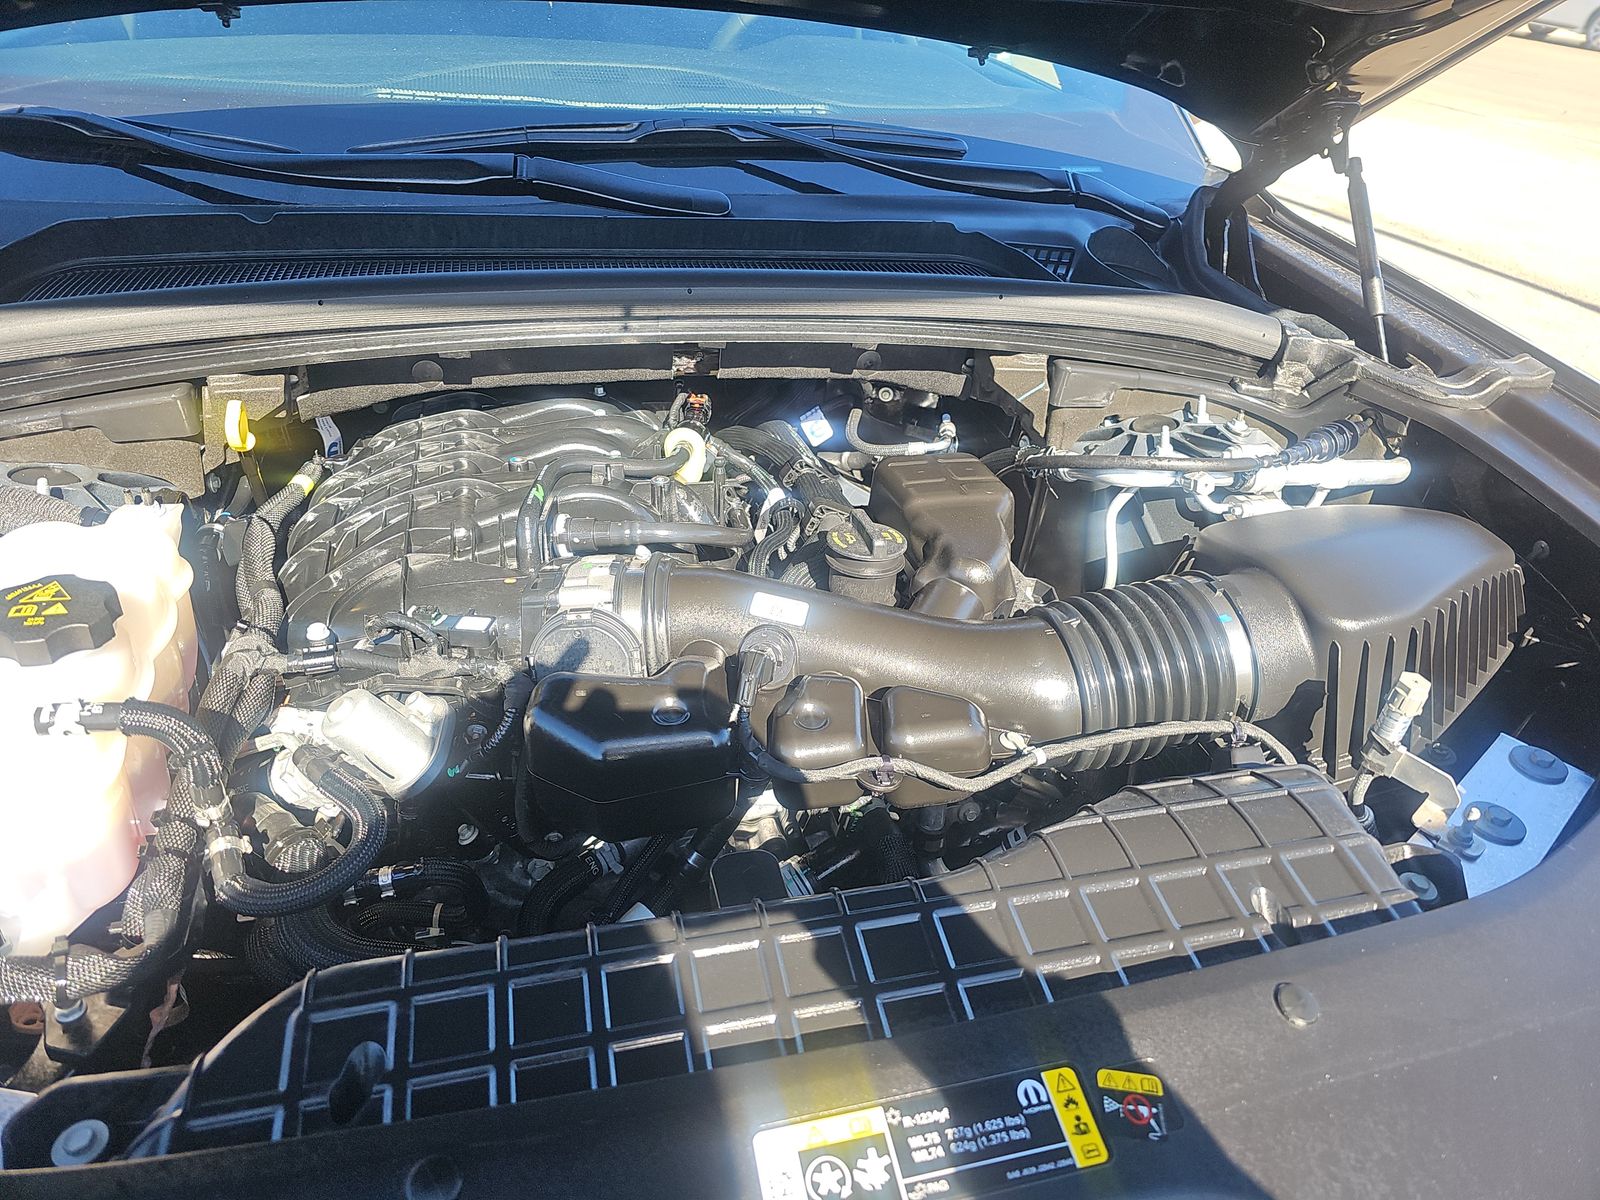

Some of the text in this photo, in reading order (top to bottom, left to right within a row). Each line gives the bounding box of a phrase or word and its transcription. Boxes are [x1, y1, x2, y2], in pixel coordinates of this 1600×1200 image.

[585, 855, 600, 876] ENG
[944, 1126, 974, 1141] 737g
[972, 1117, 1005, 1136] (1.625
[1003, 1112, 1027, 1127] lbs)
[976, 1130, 1010, 1150] (1.375
[1008, 1126, 1032, 1140] lbs)
